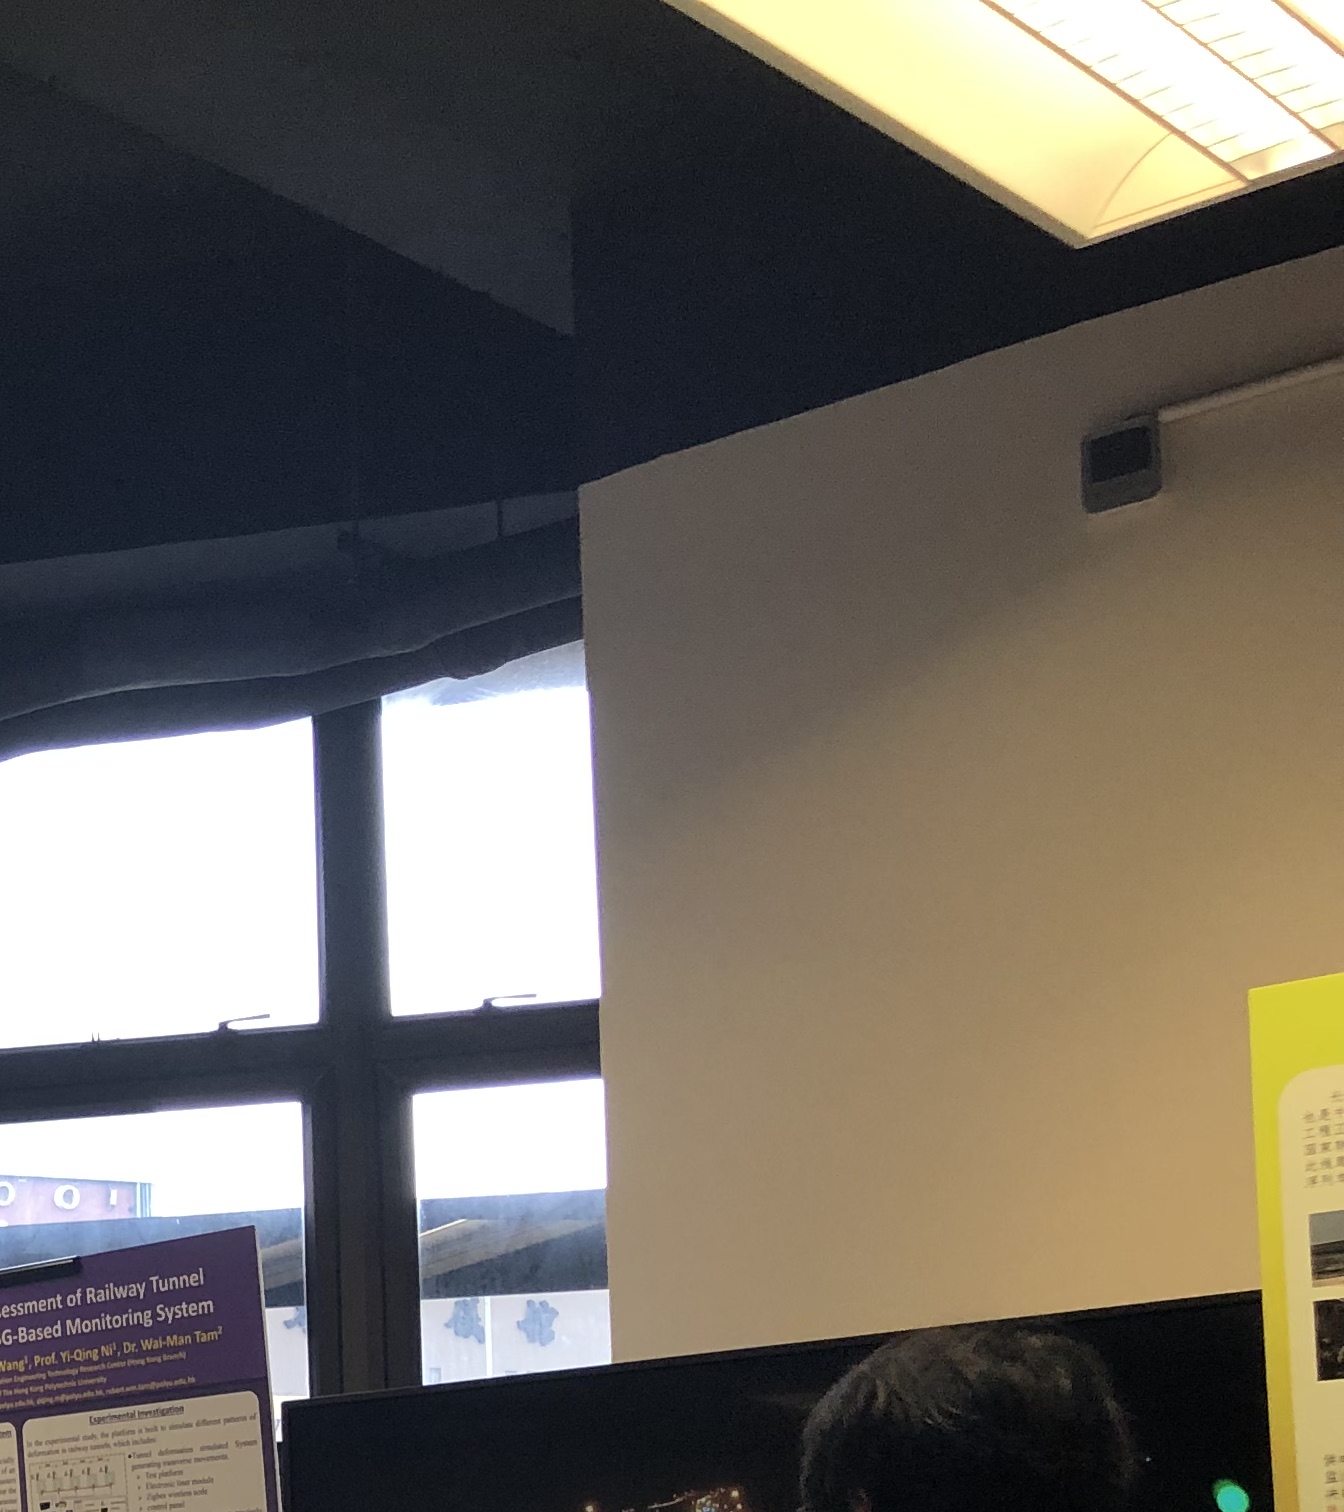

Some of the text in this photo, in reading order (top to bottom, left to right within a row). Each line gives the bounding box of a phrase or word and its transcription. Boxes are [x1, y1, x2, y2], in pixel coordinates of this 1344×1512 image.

[67, 1289, 82, 1307] of
[86, 1282, 145, 1302] Railway
[150, 1267, 204, 1293] Tunnel
[66, 1308, 152, 1335] Monitoring
[156, 1299, 214, 1323] System
[34, 1354, 57, 1367] Prof.
[61, 1348, 98, 1362] Yi-Qing
[123, 1341, 138, 1353] Dr.
[141, 1333, 191, 1350] Wai-Man
[89, 1405, 184, 1425] Experimental Investigation
